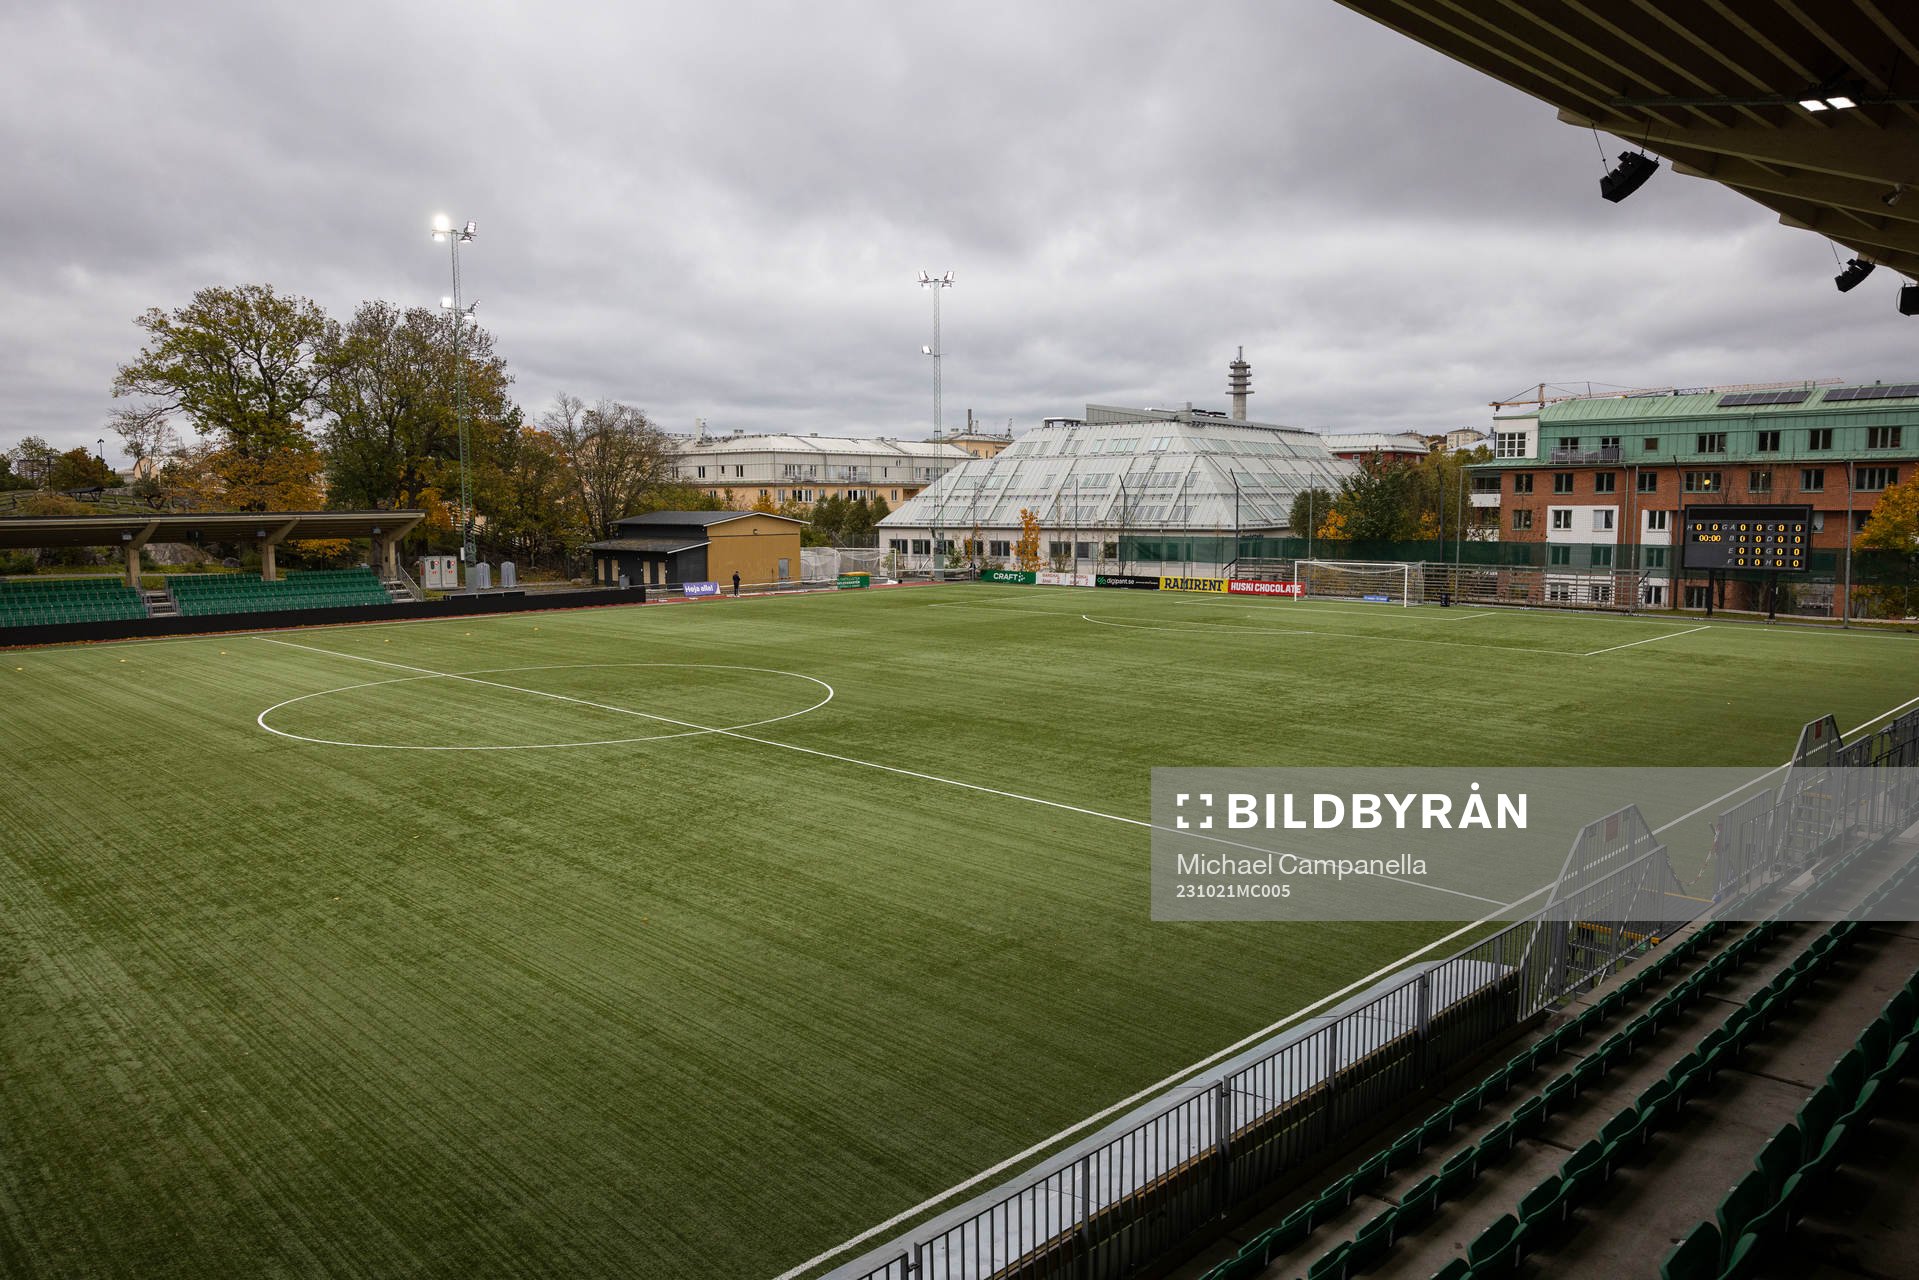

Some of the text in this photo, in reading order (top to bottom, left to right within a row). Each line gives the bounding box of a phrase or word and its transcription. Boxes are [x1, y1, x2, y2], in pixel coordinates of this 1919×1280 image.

[993, 572, 1018, 580] CRAFT
[684, 585, 700, 593] Heja
[1164, 578, 1224, 592] RAMIRENT
[1231, 582, 1302, 594] HUSKI CHOCOLATE
